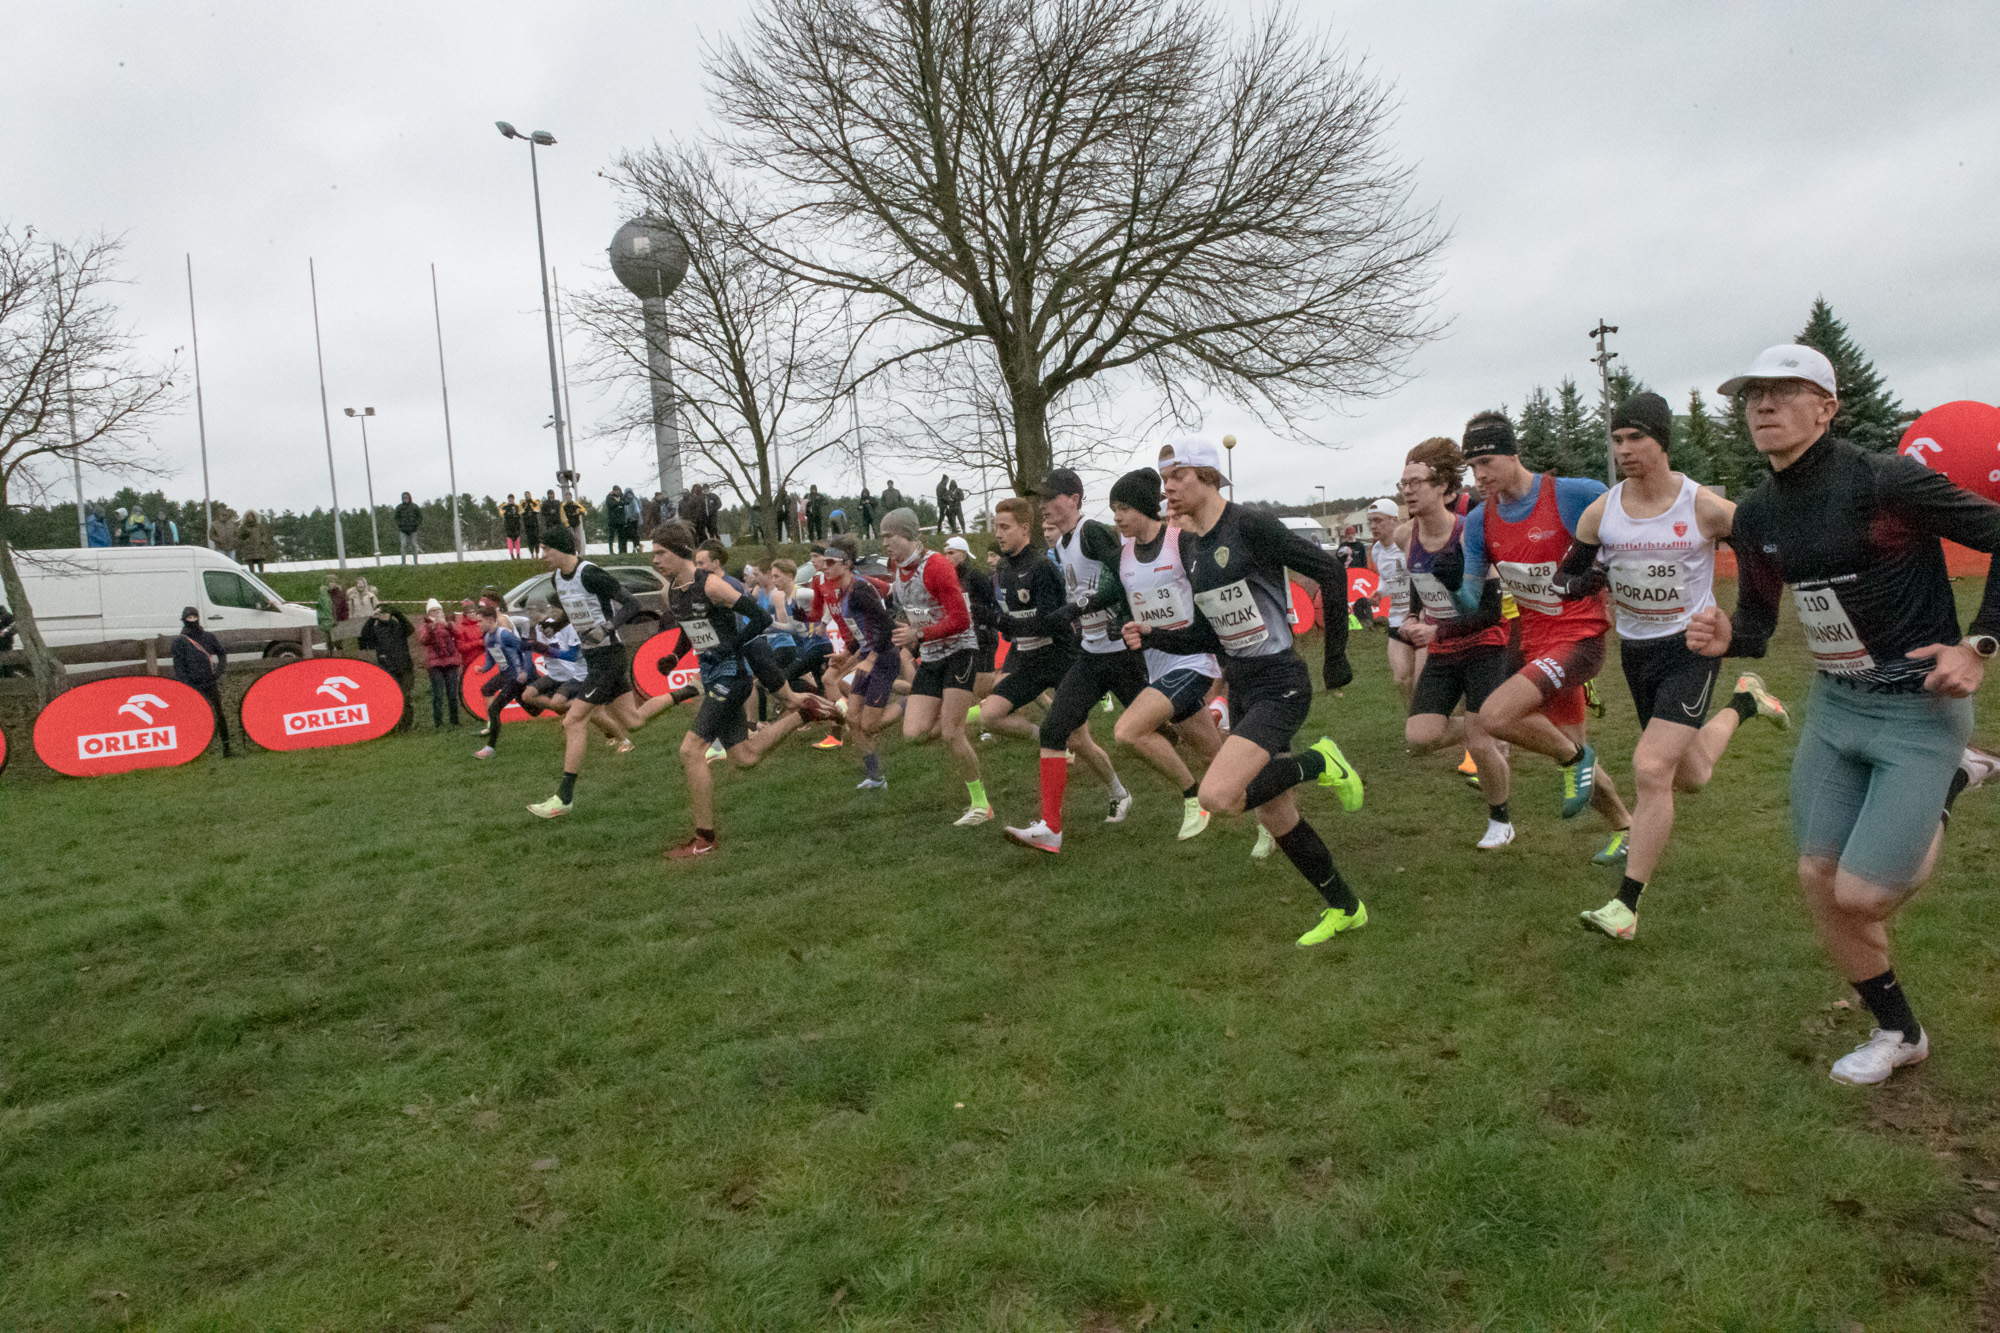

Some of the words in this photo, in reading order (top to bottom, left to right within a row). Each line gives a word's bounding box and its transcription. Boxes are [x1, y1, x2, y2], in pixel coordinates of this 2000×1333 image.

[1528, 566, 1551, 577] 128
[1648, 565, 1676, 577] 385
[1157, 588, 1170, 600] 33
[1220, 586, 1243, 602] 473
[1615, 581, 1679, 602] PORADA
[1803, 595, 1829, 612] 110
[1140, 606, 1175, 622] JANAS
[1846, 660, 1865, 669] 2023
[289, 707, 364, 731] ORLEN
[84, 730, 170, 755] ORLEN
